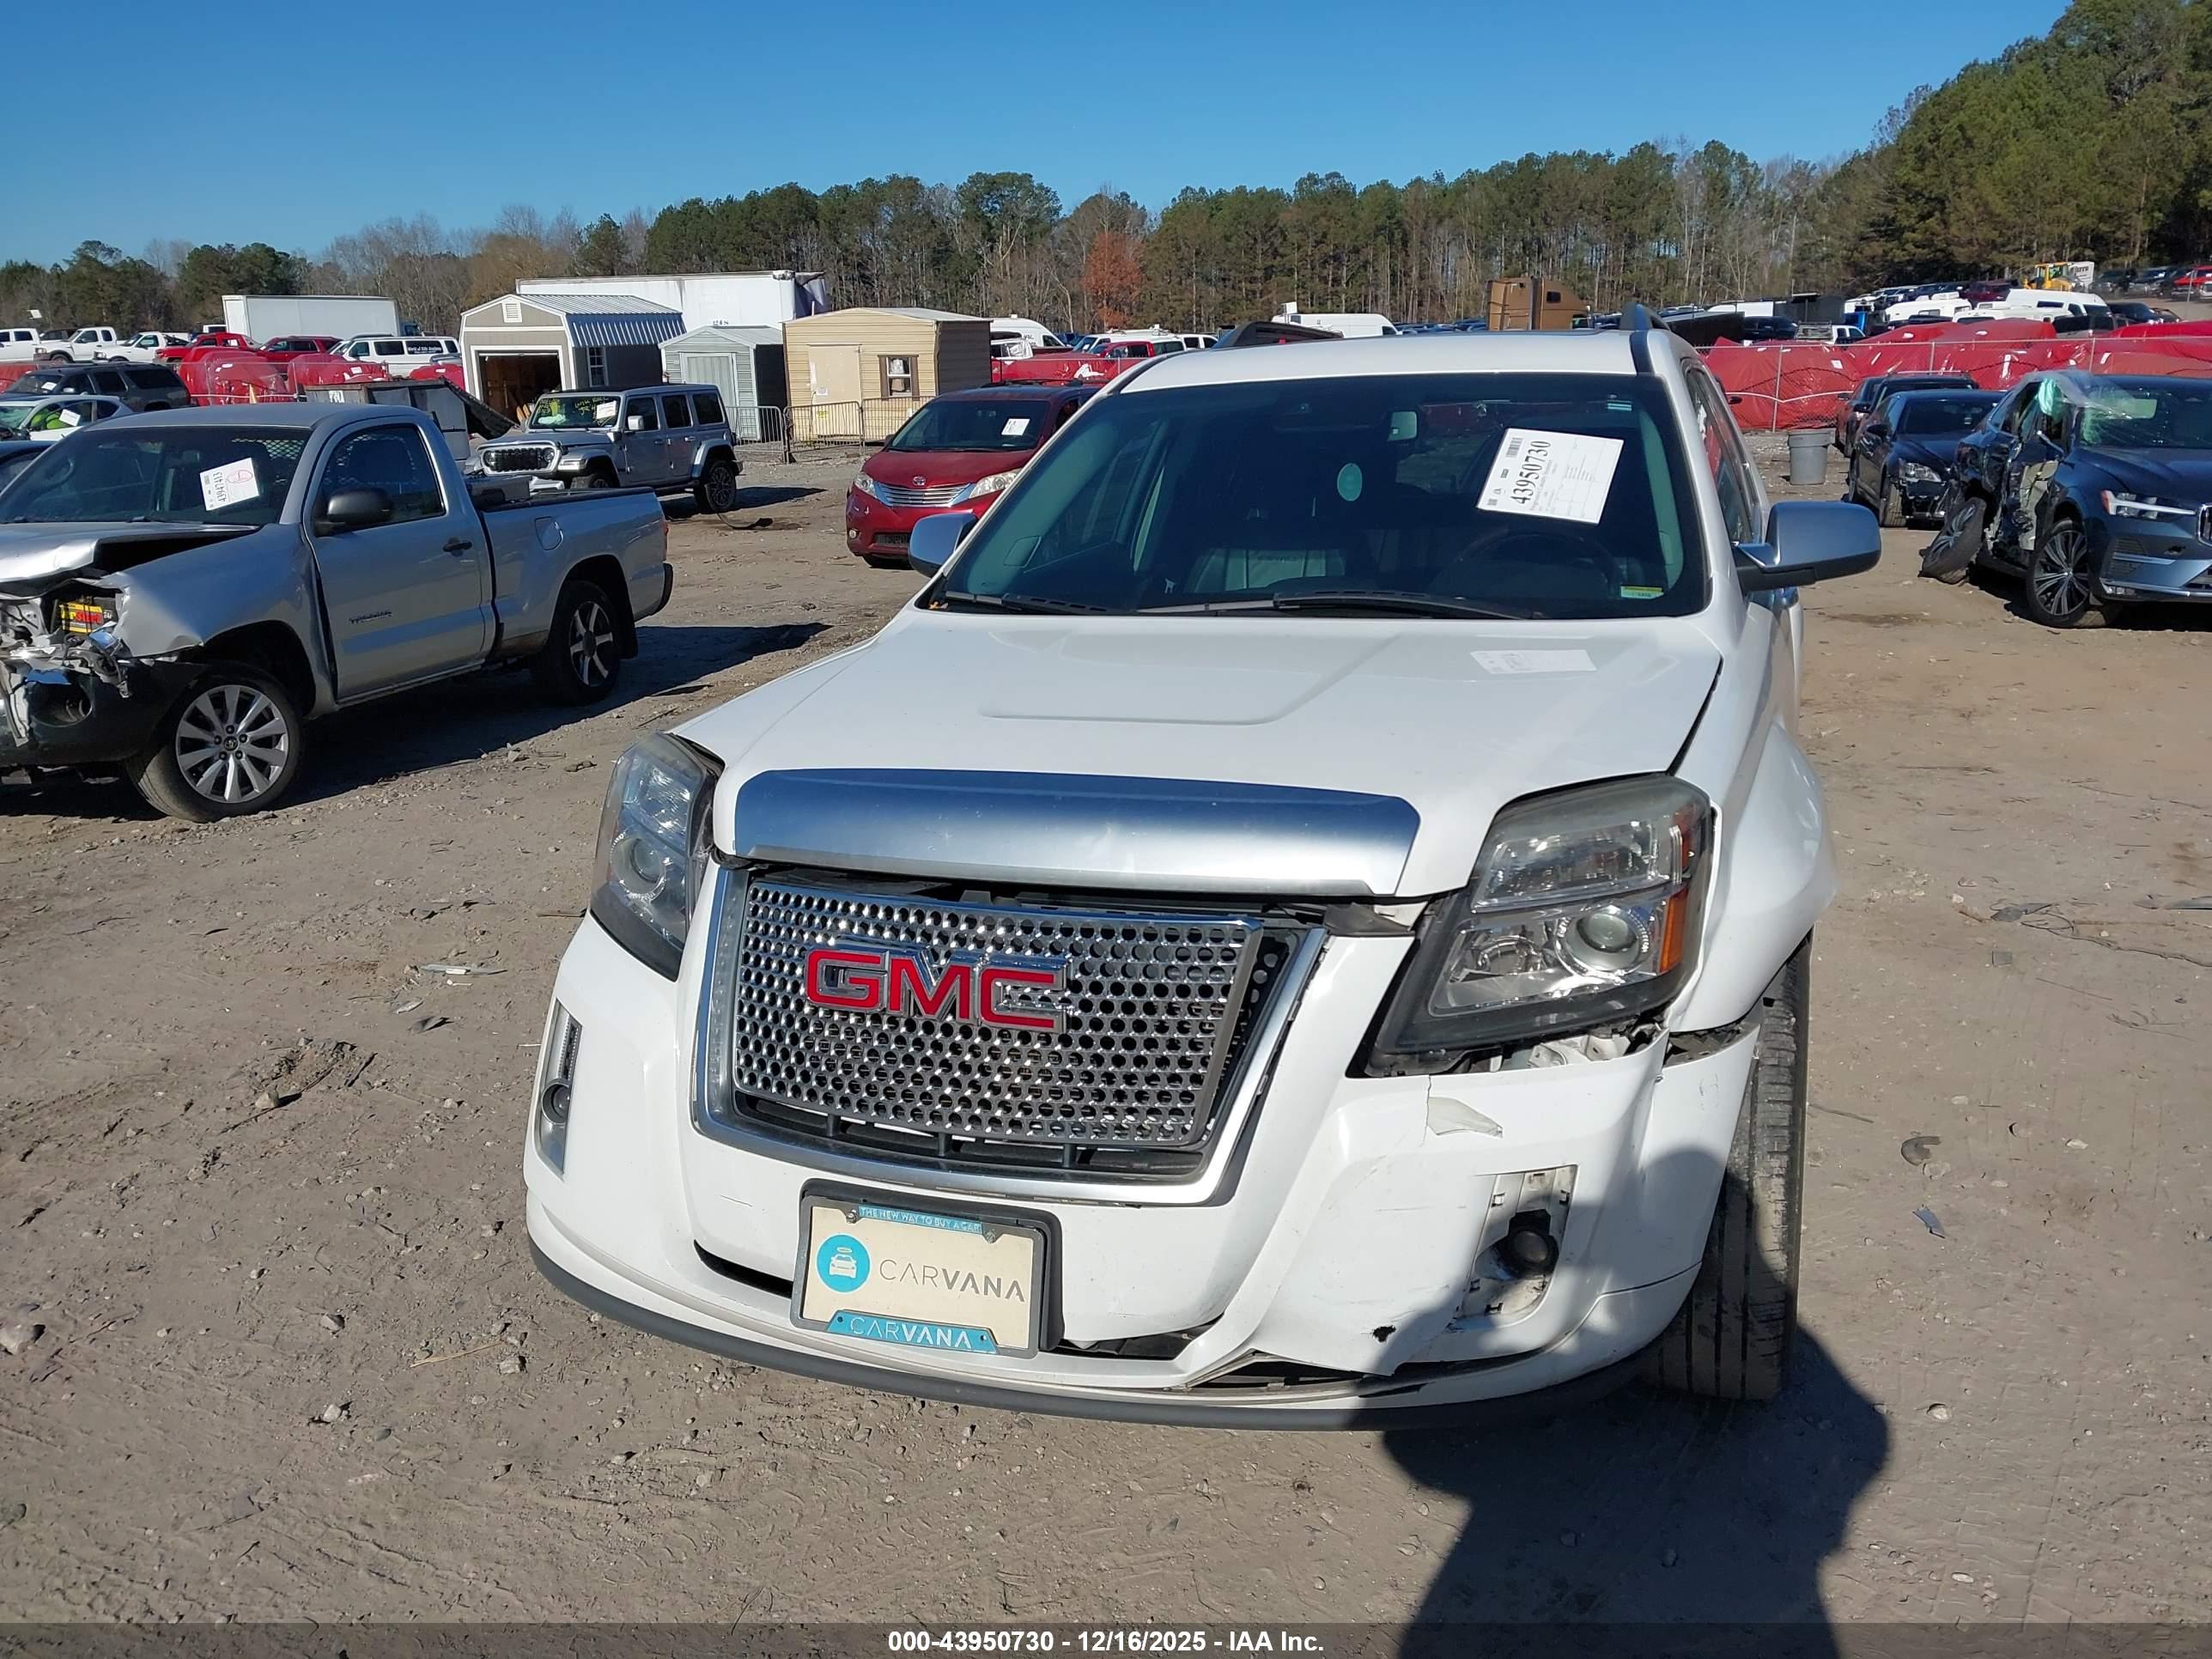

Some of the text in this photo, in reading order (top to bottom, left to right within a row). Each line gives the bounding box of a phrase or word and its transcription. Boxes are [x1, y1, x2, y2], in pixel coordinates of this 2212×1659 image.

[1510, 441, 1551, 504] 43950730
[805, 948, 1066, 1031] GMC
[860, 1207, 982, 1233] THE NEW WAY TO BUY A CAR
[879, 1259, 1025, 1303] CARVANA
[850, 1318, 972, 1349] CARVANA
